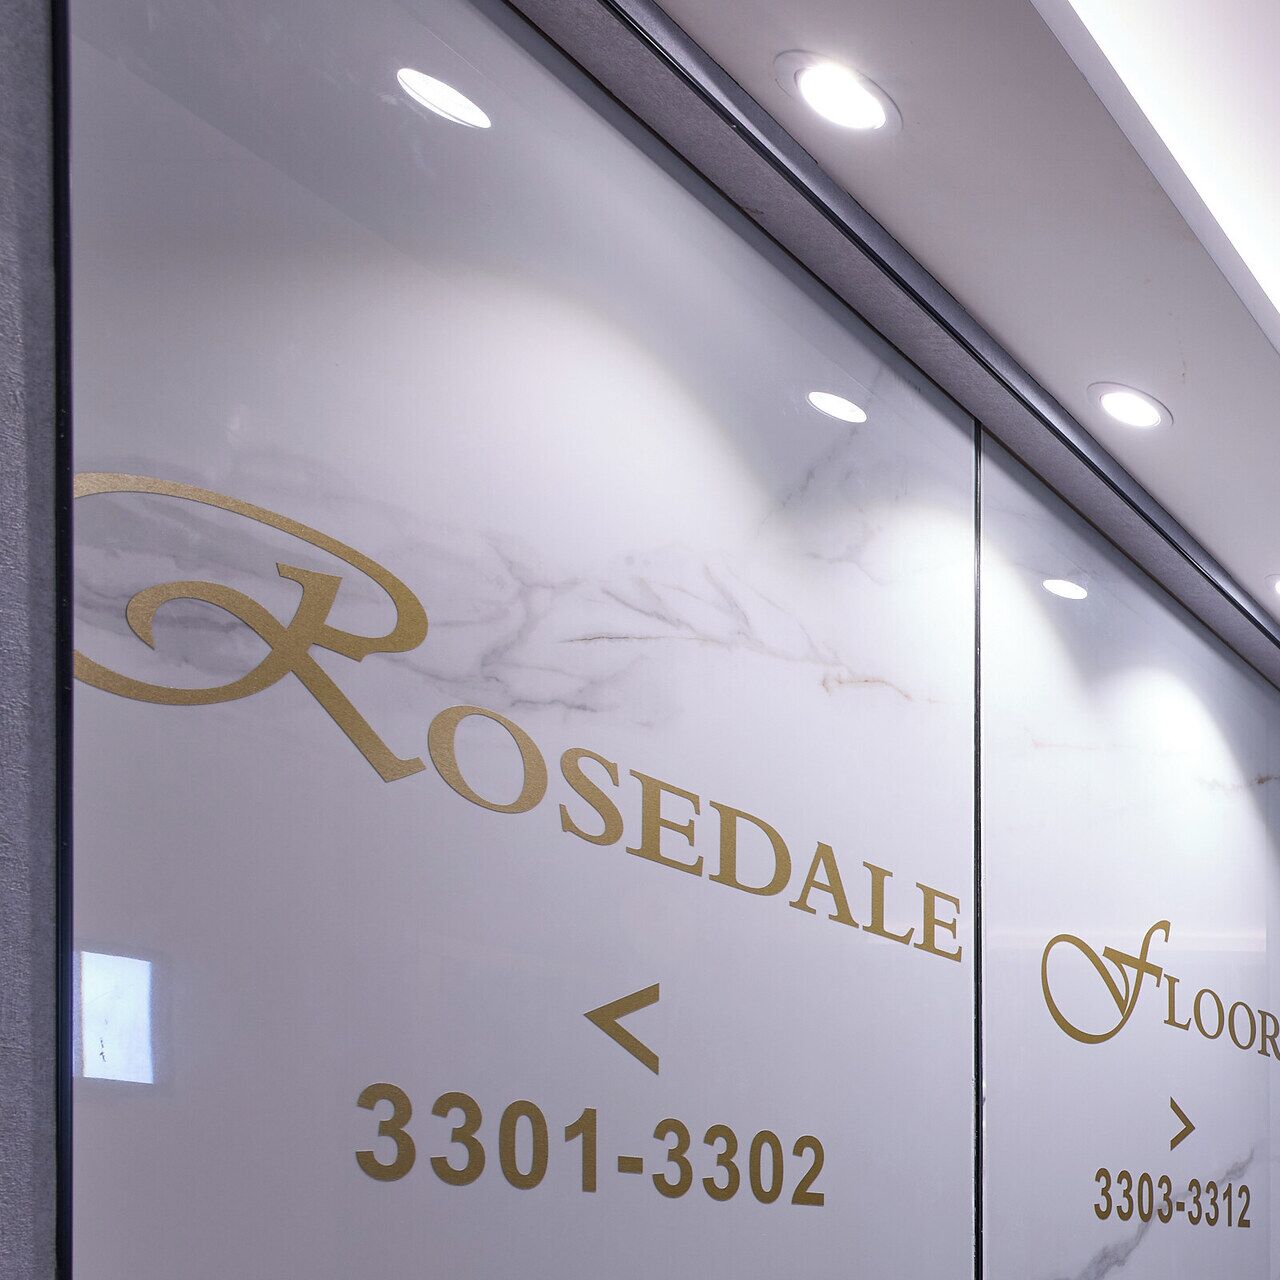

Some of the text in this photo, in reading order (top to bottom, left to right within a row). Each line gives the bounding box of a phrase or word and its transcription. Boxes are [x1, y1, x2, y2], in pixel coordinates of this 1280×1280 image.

[74, 472, 963, 963] ROSEDALE
[355, 1082, 826, 1207] 3301-3302
[1094, 1168, 1251, 1228] 3303-3312
